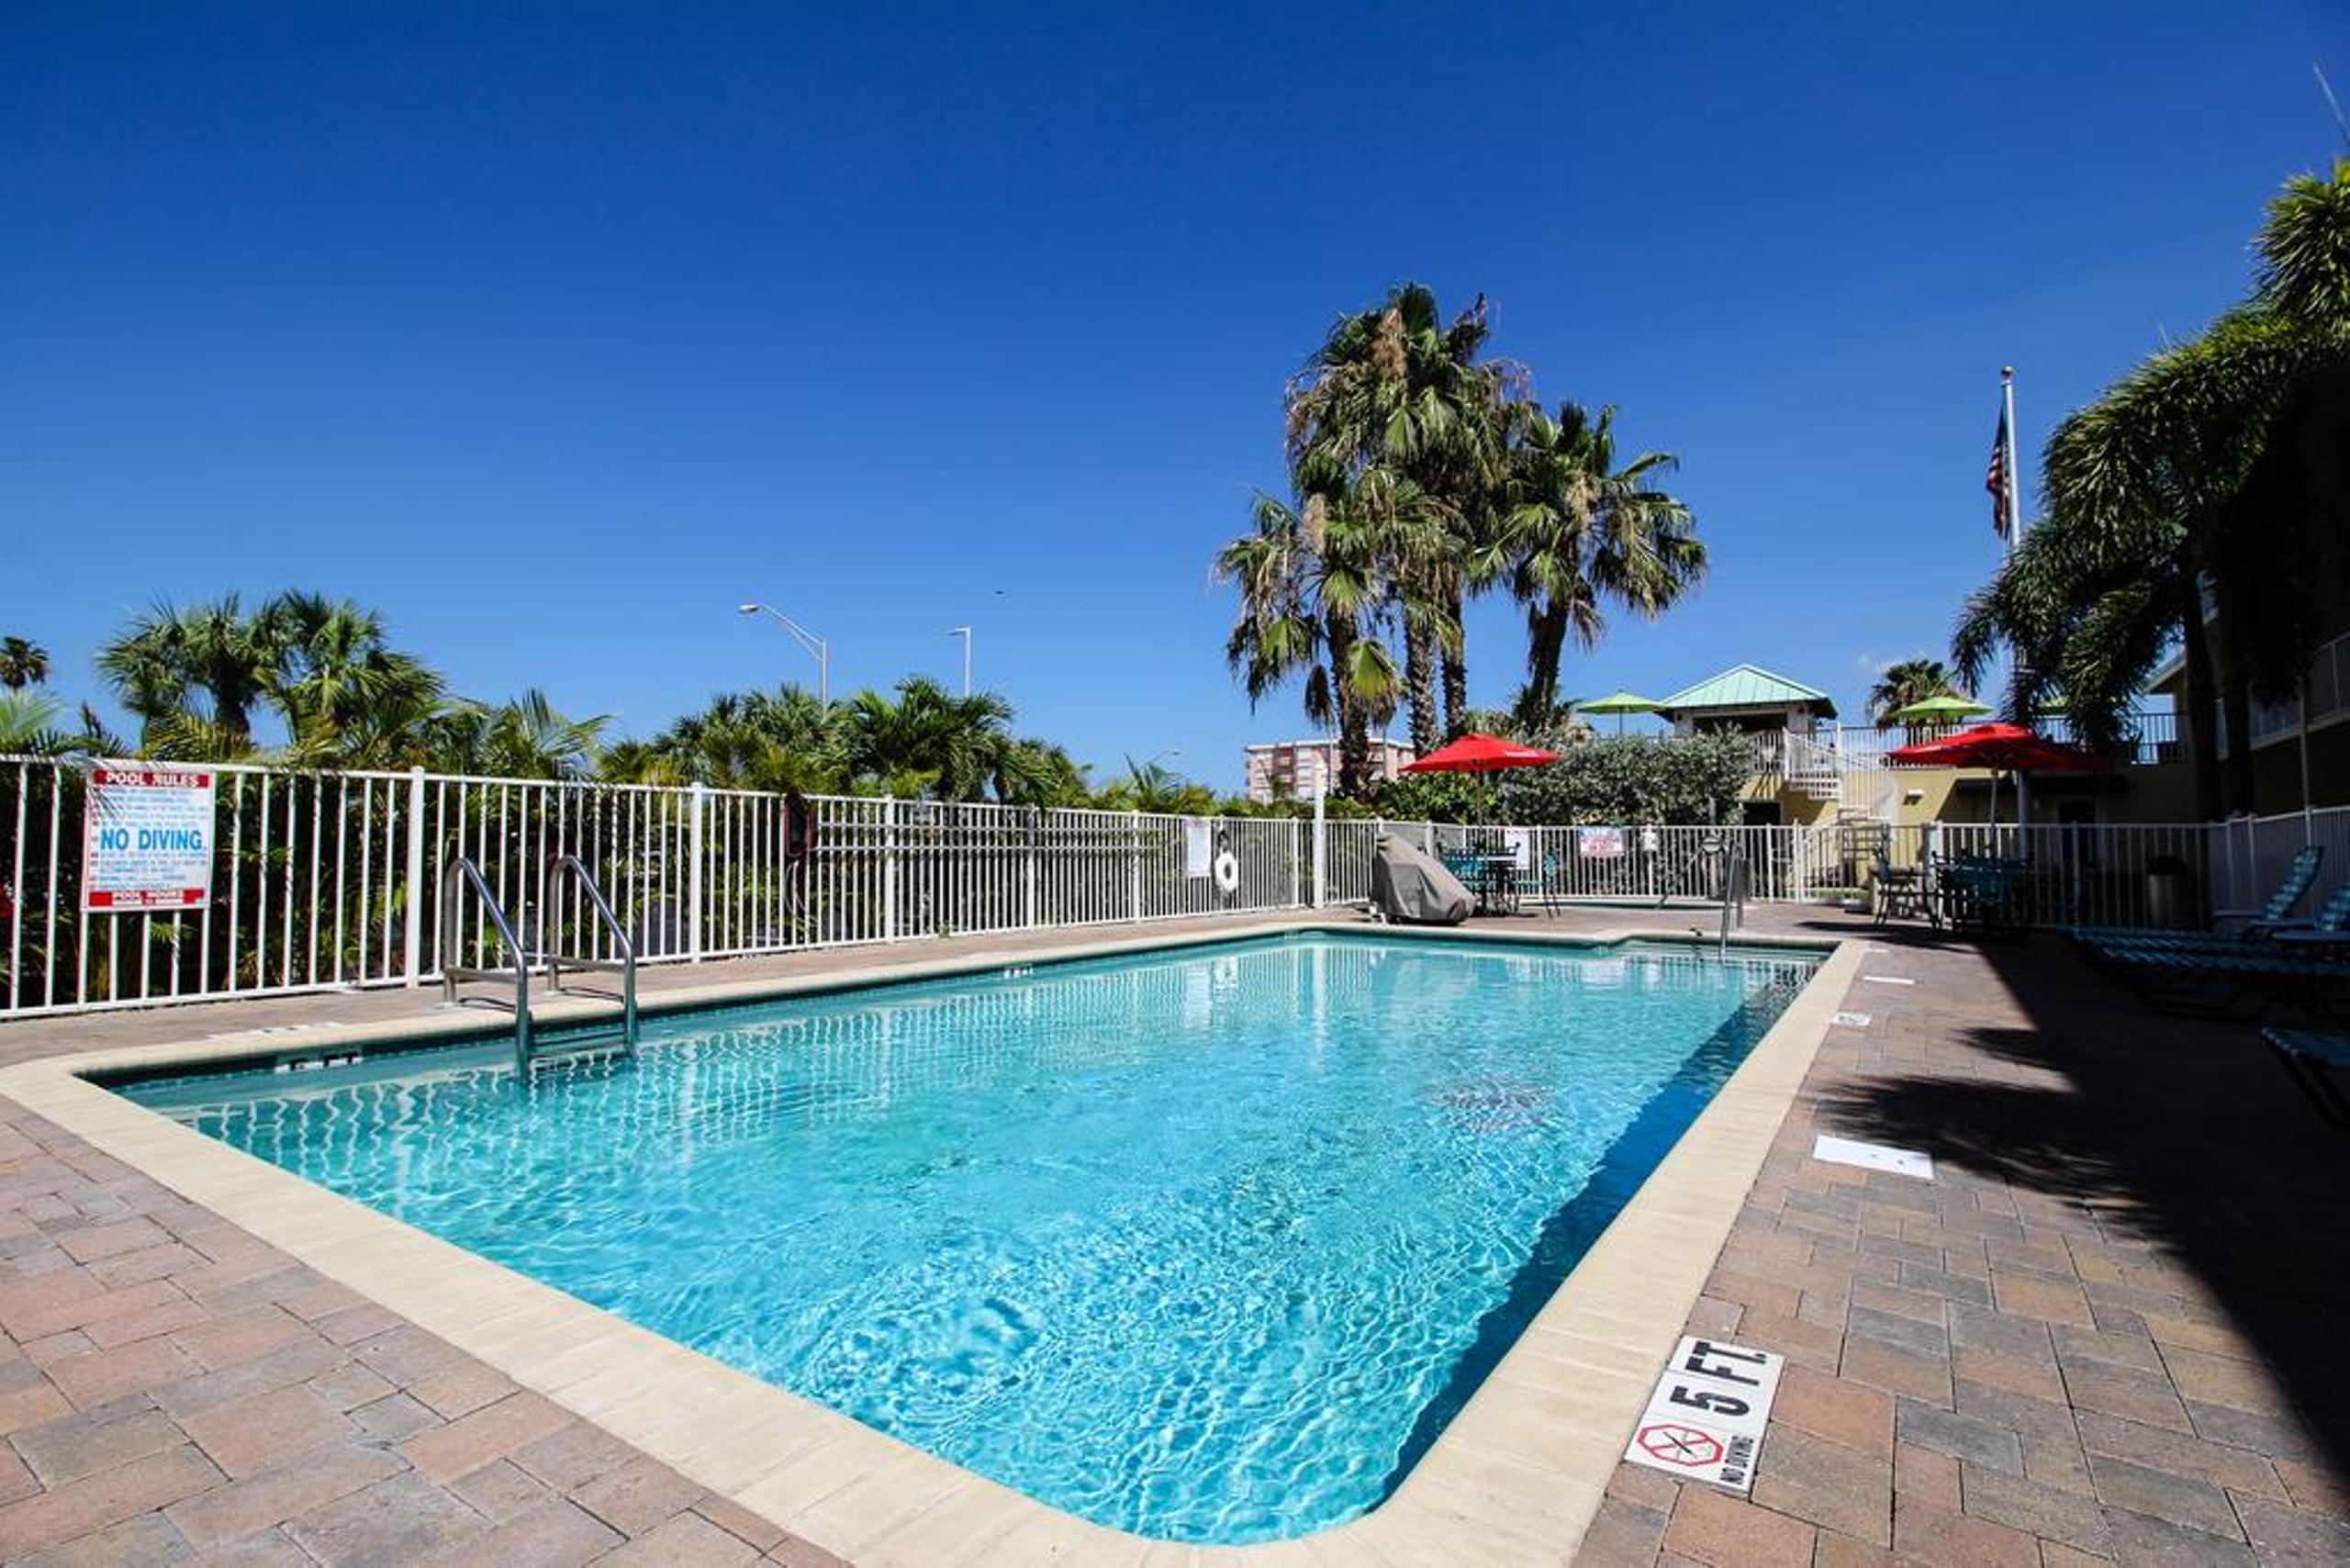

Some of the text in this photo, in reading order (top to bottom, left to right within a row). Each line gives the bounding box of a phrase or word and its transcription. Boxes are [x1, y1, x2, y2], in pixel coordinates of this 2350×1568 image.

[106, 772, 199, 787] POOL RULES
[101, 830, 129, 849] NO
[1670, 1385, 1750, 1417] 5
